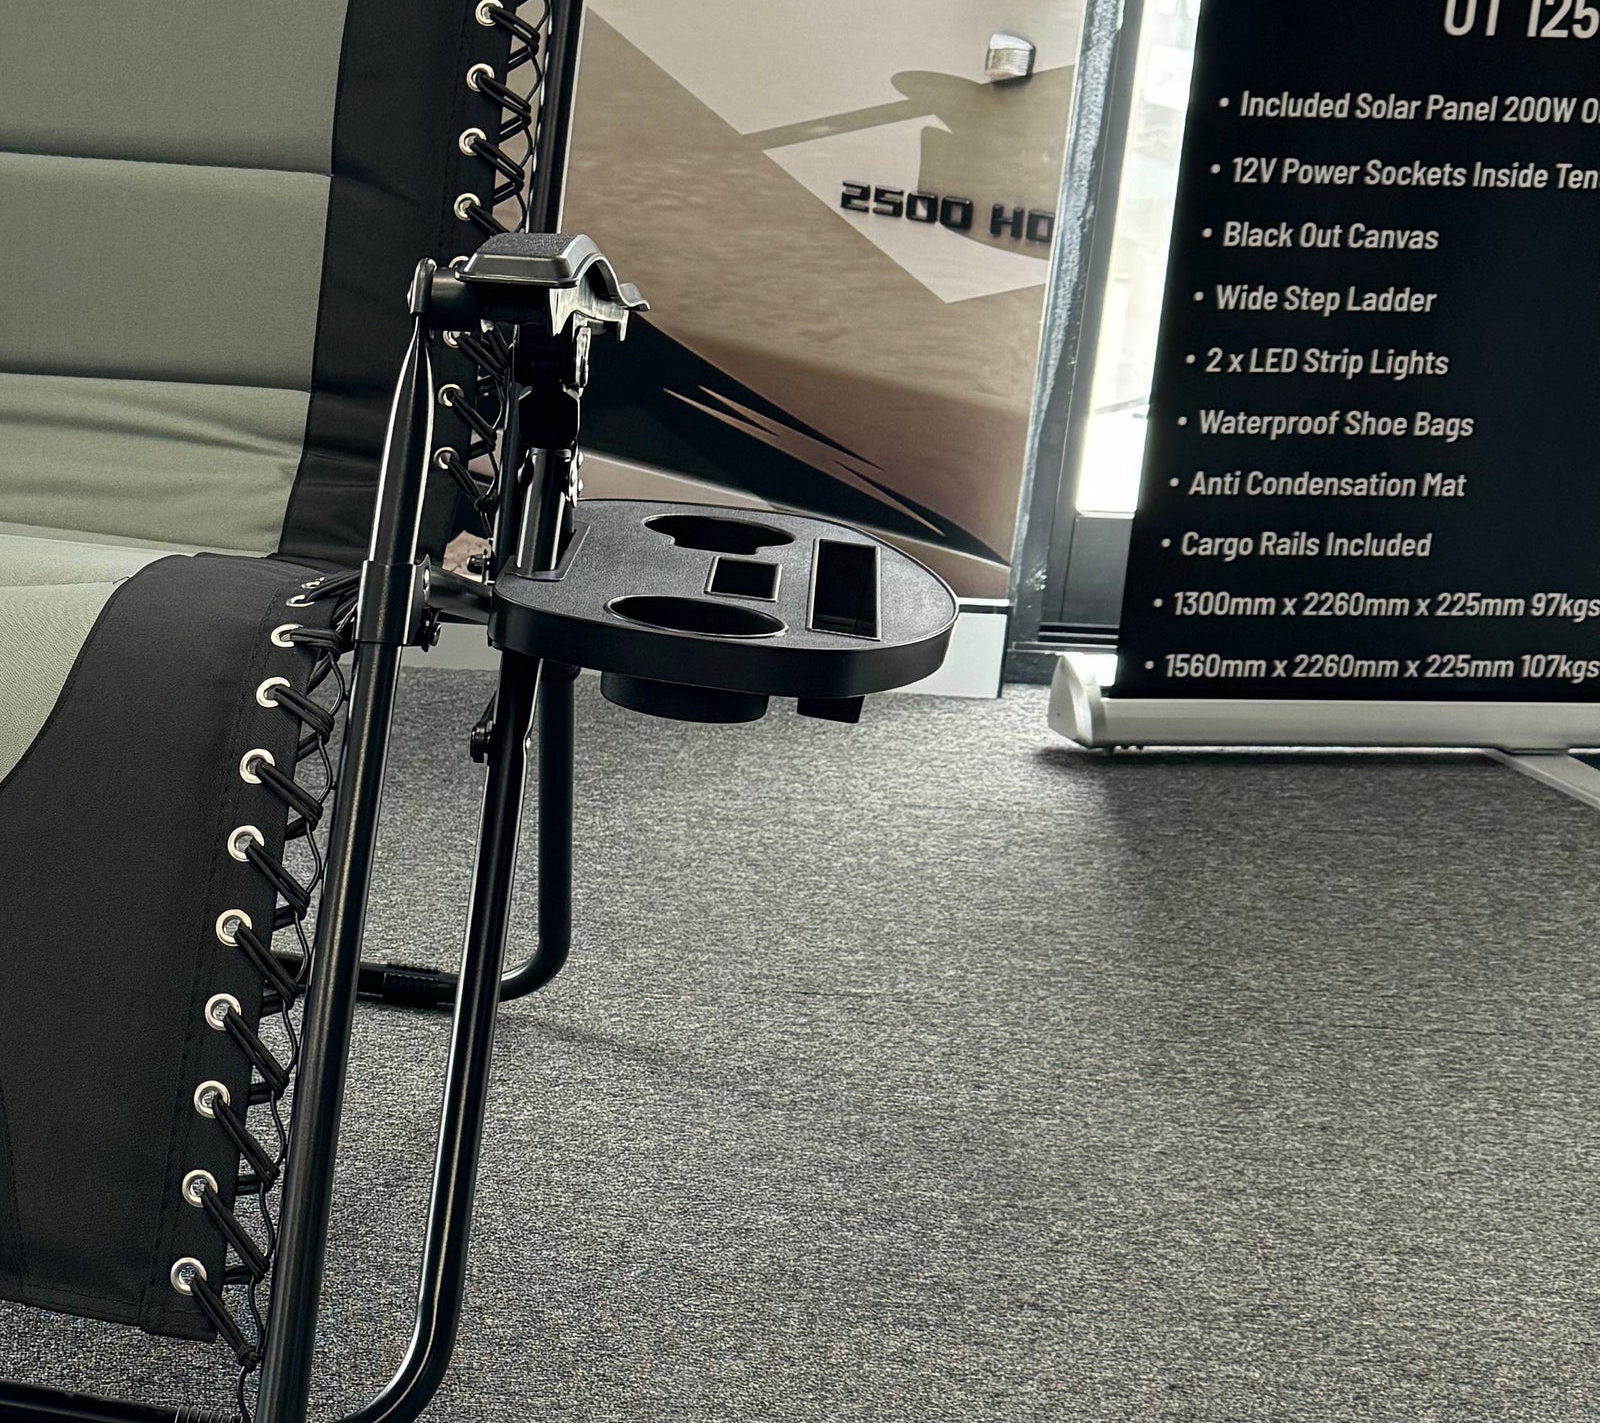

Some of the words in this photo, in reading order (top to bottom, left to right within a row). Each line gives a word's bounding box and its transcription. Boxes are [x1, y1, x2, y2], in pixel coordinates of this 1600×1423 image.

[1240, 90, 1351, 119] Included
[1355, 92, 1422, 120] Solar
[1425, 94, 1499, 122] Panel
[1502, 95, 1578, 123] 200W
[1233, 157, 1278, 184] 12V
[1281, 157, 1361, 185] Power
[1364, 159, 1467, 187] Sockets
[1472, 161, 1549, 189] Inside
[1555, 163, 1600, 189] Ten
[840, 181, 973, 230] 2500
[1223, 221, 1294, 248] Black
[1299, 222, 1343, 248] Out
[1347, 222, 1440, 250] Canvas
[1216, 284, 1278, 311] Wide
[1283, 285, 1341, 317] Step
[1346, 285, 1438, 313] Ladder
[1205, 347, 1223, 373] 2
[1227, 353, 1245, 373] x
[1249, 347, 1298, 373] LED
[1302, 347, 1364, 380] Strip
[1370, 348, 1449, 381] Lights
[1199, 409, 1341, 441] Waterproof
[1344, 410, 1408, 436] Shoe
[1413, 411, 1475, 443] Bags
[1188, 470, 1242, 495] Anti
[1246, 470, 1417, 497] Condensation
[1421, 472, 1468, 497] Mat
[1181, 531, 1254, 562] Cargo
[1259, 531, 1320, 556] Rails
[1325, 531, 1433, 557] Included
[1174, 591, 1276, 616] 1300mm
[1281, 597, 1298, 616] x
[1302, 591, 1410, 616] 2260mm
[1414, 598, 1431, 616] x
[1435, 592, 1526, 617] 225mm
[1530, 592, 1600, 623] 97kgs
[1165, 653, 1267, 678] 1560mm
[1271, 659, 1289, 678] x
[1292, 653, 1399, 678] 2260mm
[1404, 660, 1421, 678] x
[1424, 654, 1515, 678] 225mm
[1521, 654, 1600, 684] 107kgs
